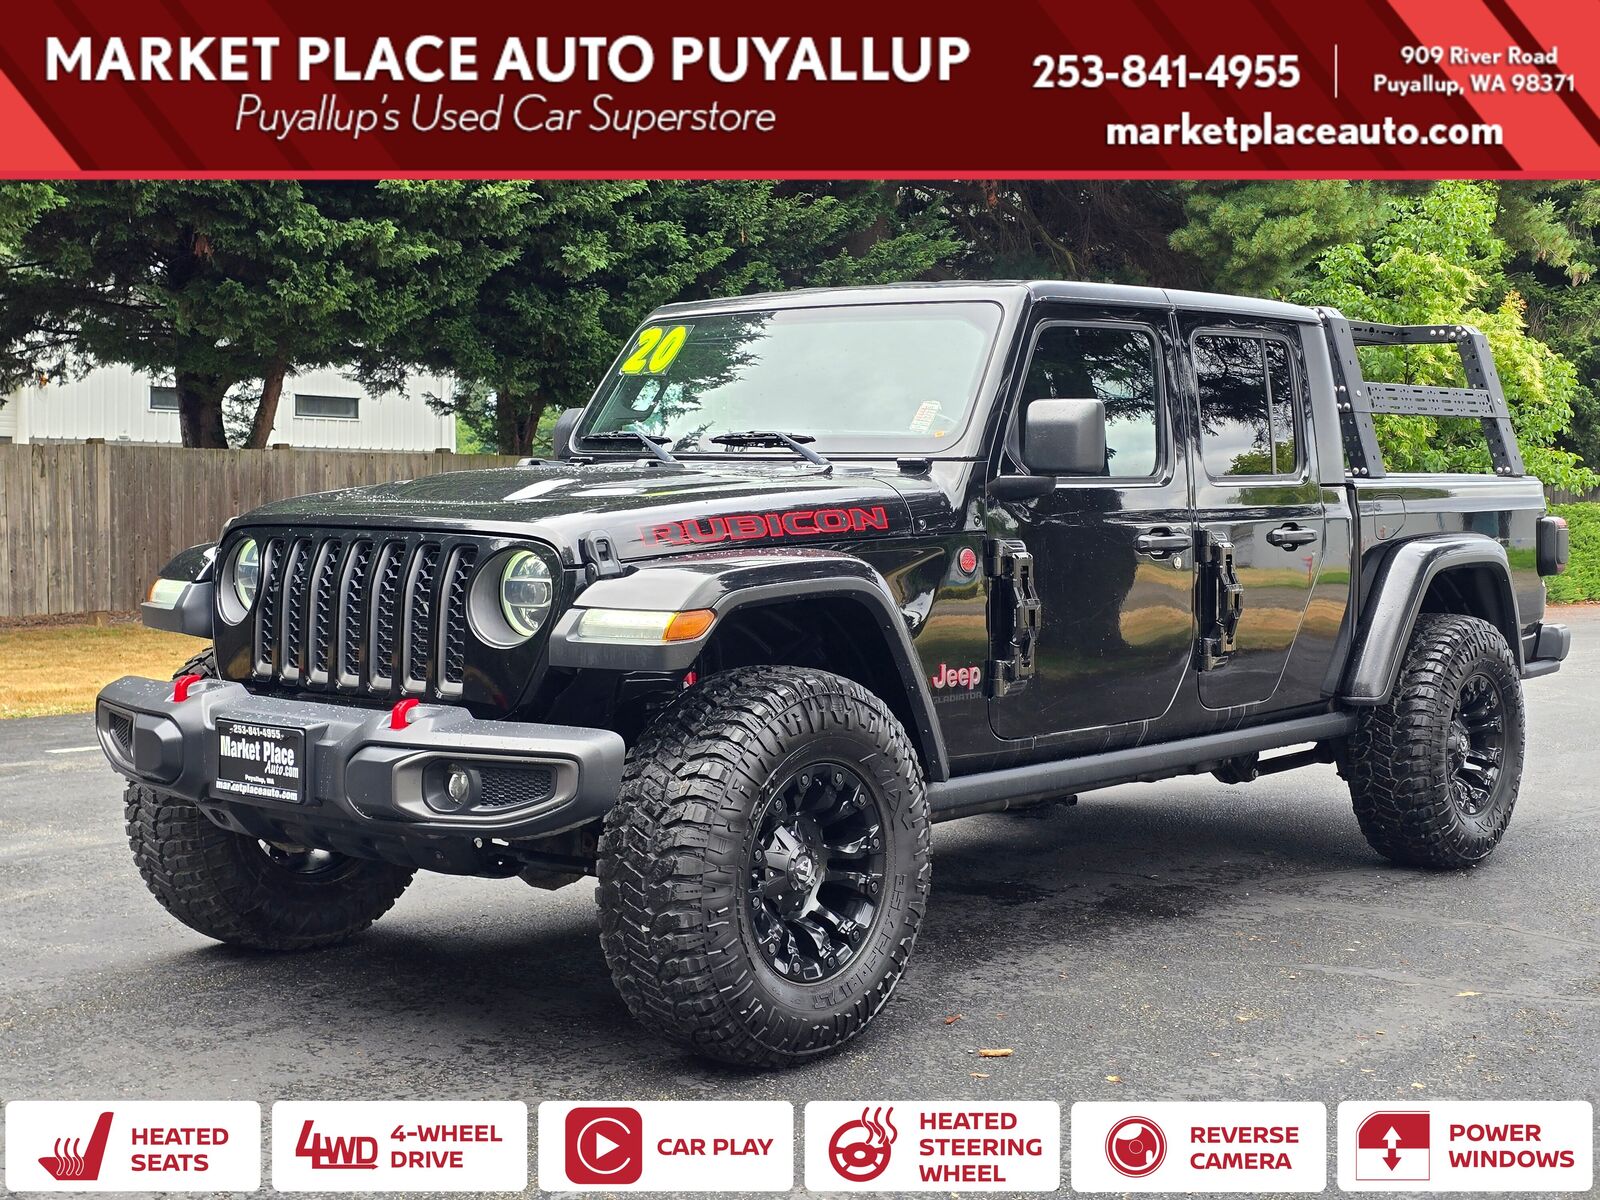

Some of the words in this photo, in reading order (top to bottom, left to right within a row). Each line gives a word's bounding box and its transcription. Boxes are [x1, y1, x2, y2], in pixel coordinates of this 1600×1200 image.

[621, 326, 687, 374] 20
[638, 506, 889, 547] RUBICON
[932, 663, 981, 689] Jeep
[220, 735, 261, 761] Market
[263, 741, 295, 766] Place
[264, 760, 299, 778] Auto.com
